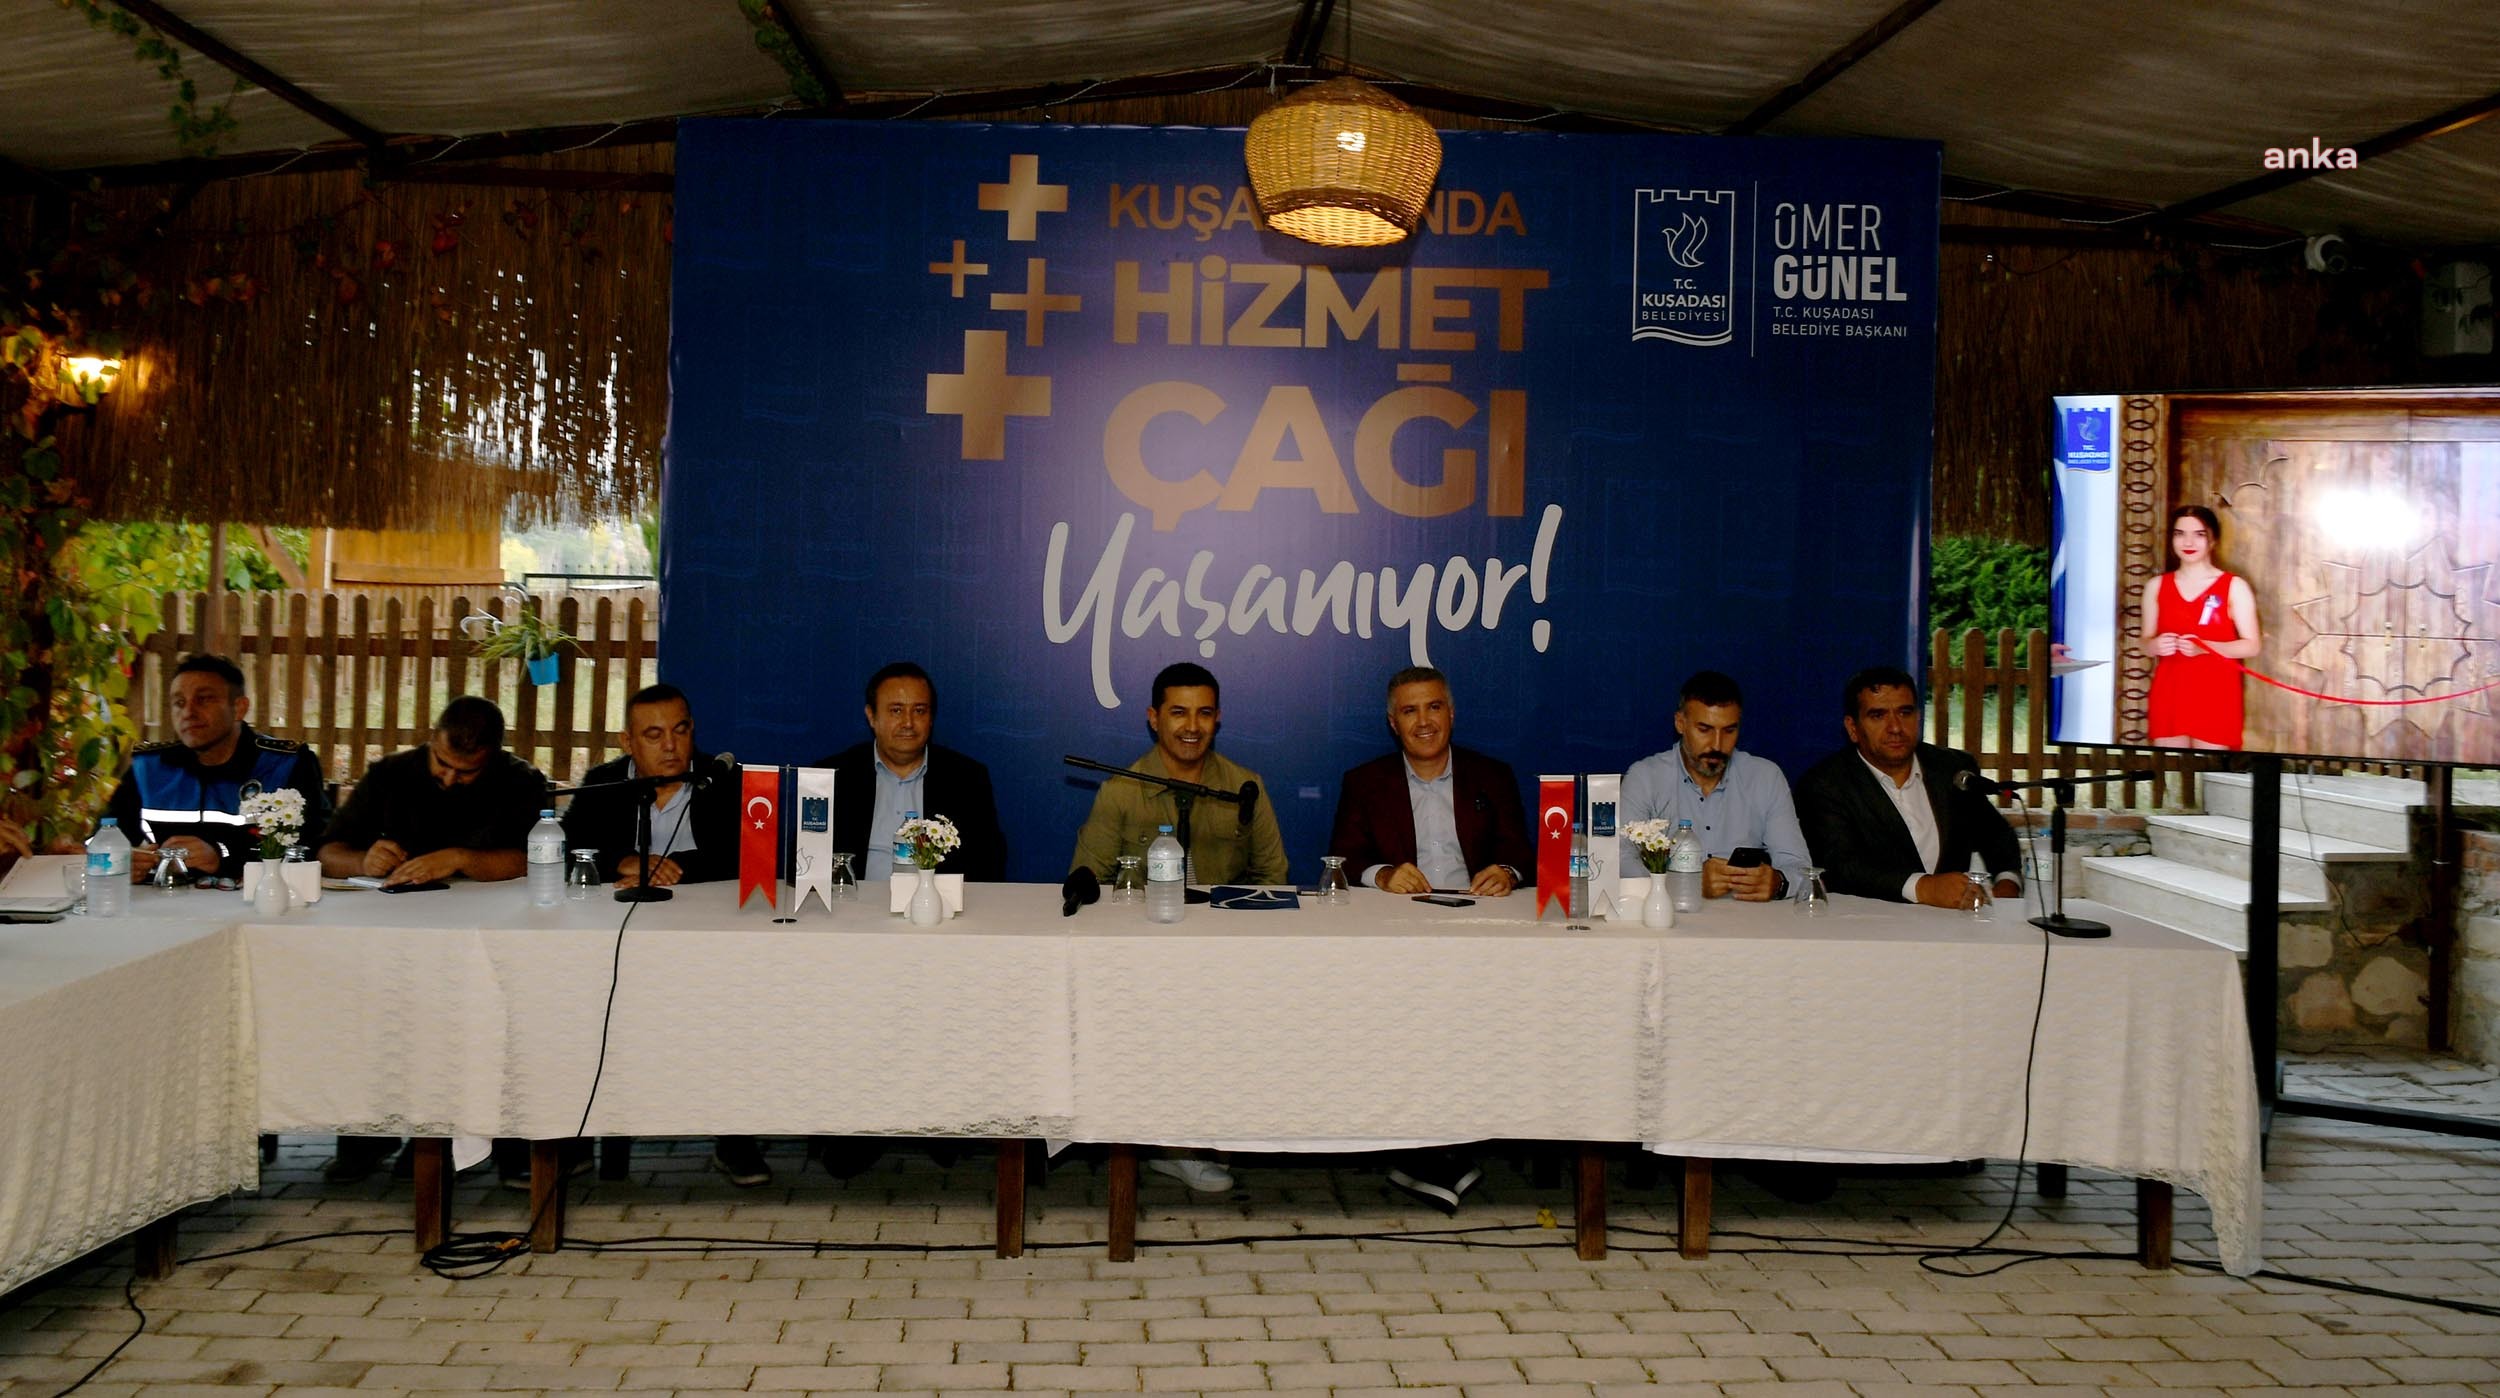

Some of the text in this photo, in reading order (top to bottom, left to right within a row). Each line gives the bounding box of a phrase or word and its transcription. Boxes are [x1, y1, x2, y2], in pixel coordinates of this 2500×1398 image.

[1673, 278, 1697, 290] T.C.
[1773, 254, 1907, 301] GÜNEL
[1642, 293, 1726, 309] KUŞADASI
[1642, 310, 1726, 322] BELEDİYESİ
[1773, 306, 1874, 321] T.C. KUŞADASI
[1772, 323, 1907, 340] BELEDİYE BAŞKANI
[1103, 363, 1527, 532] ÇAĞI
